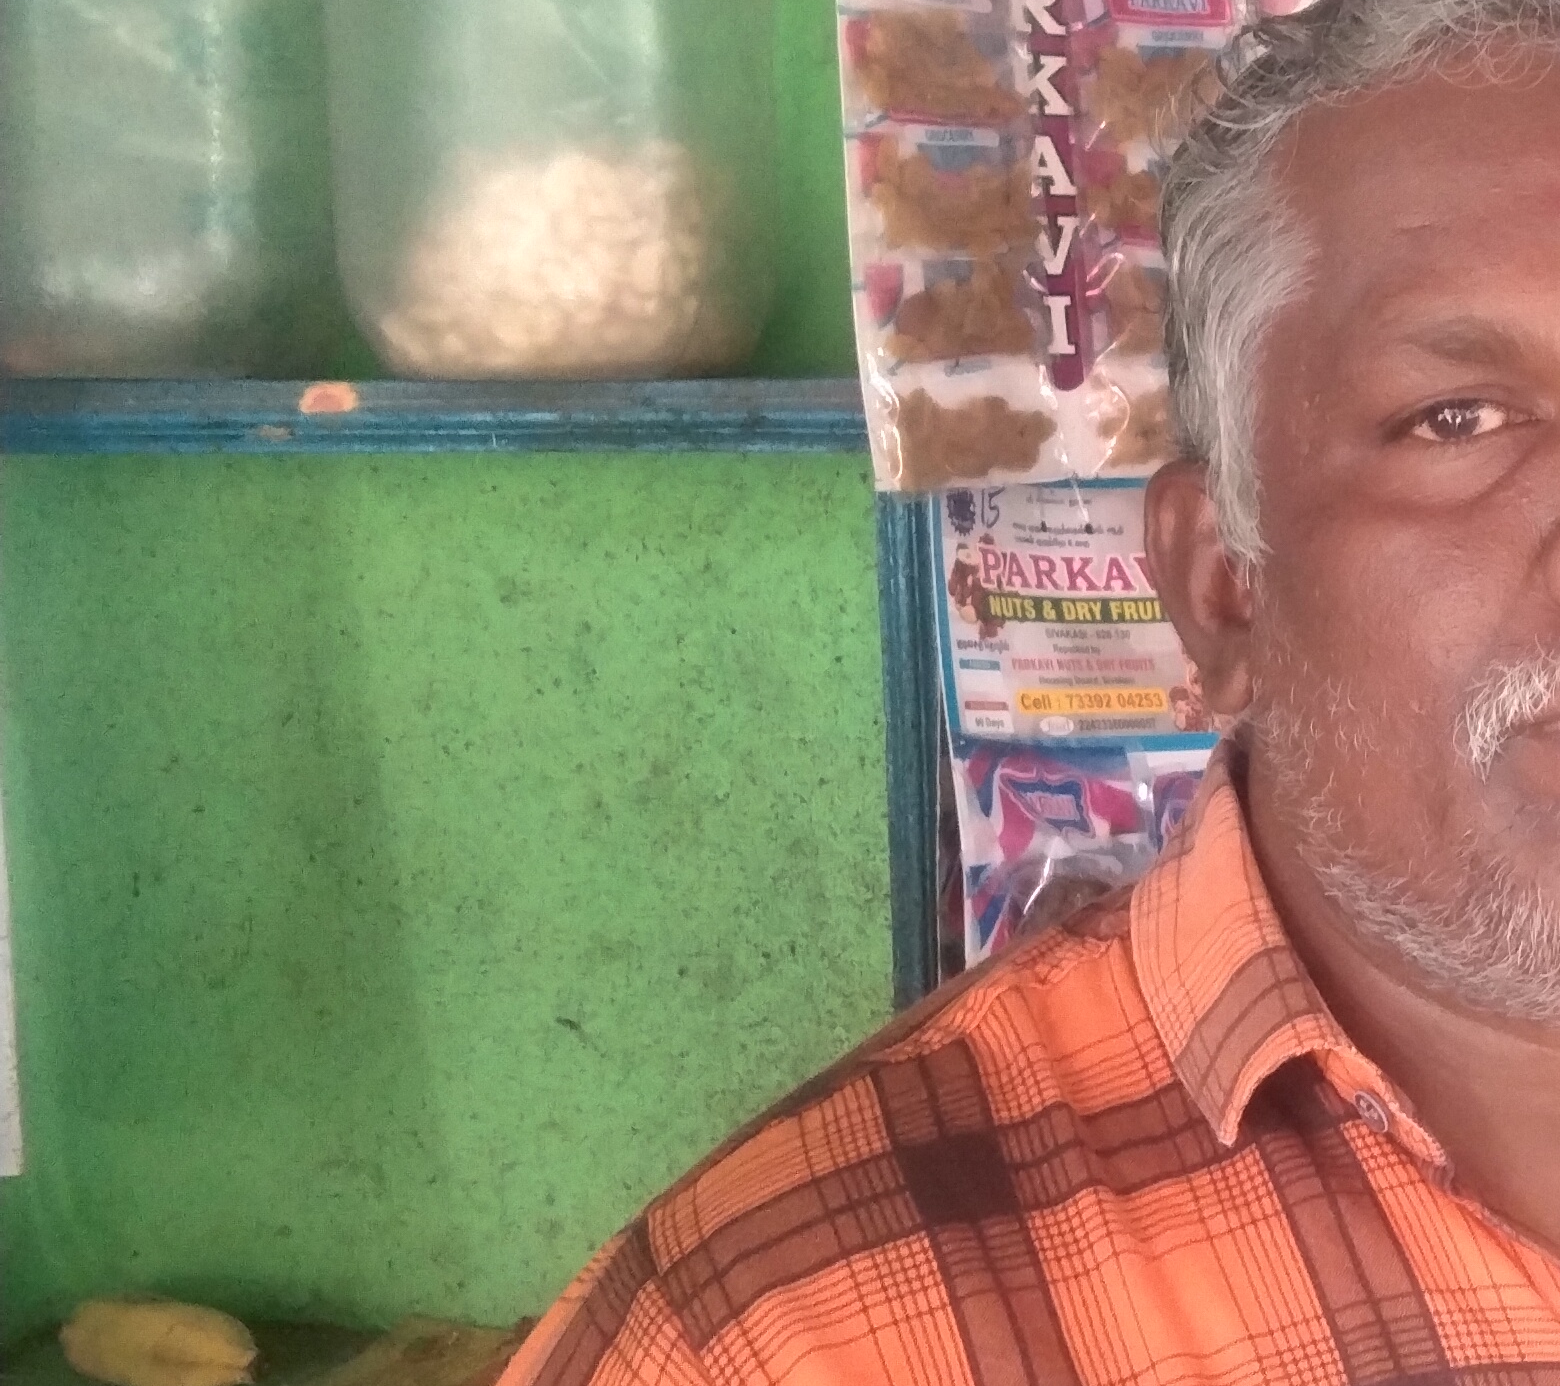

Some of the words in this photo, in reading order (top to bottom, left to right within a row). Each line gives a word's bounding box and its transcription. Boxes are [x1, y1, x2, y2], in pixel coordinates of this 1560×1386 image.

[981, 485, 1006, 529] 15
[978, 545, 1157, 593] PARKA
[989, 594, 1036, 620] NUTS
[1042, 599, 1057, 621] &
[1060, 599, 1102, 622] DRY
[1110, 599, 1161, 622] FRUI
[1020, 692, 1053, 710] Cell
[1064, 693, 1112, 710] 73392
[1116, 692, 1164, 708] 04253
